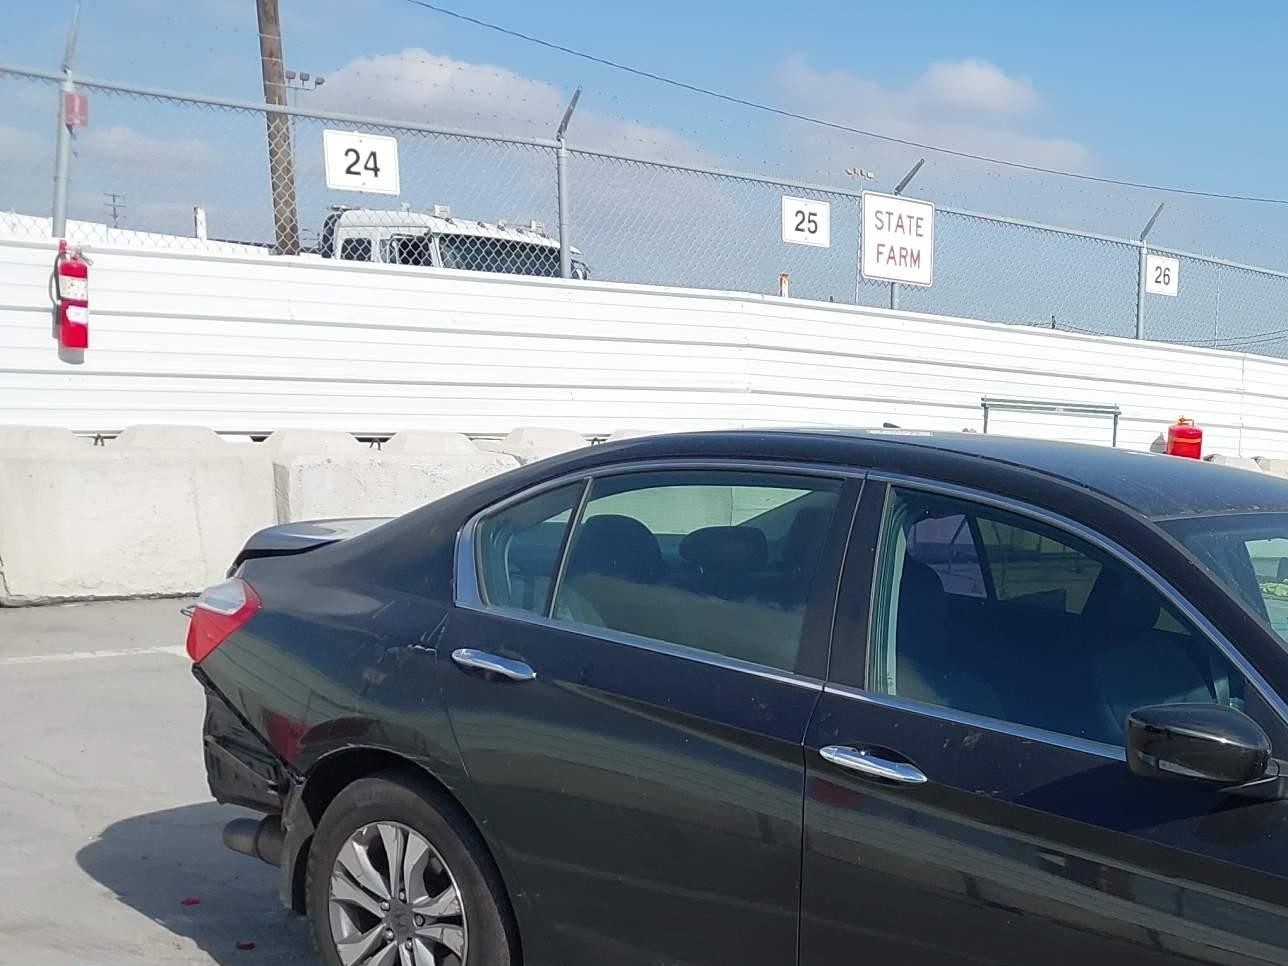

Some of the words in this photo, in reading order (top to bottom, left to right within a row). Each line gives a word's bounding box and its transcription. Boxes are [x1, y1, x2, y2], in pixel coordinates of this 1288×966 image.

[344, 148, 380, 178] 24
[794, 210, 818, 234] 25
[874, 210, 924, 237] STATE
[876, 243, 921, 269] FARM
[1154, 265, 1171, 286] 26
